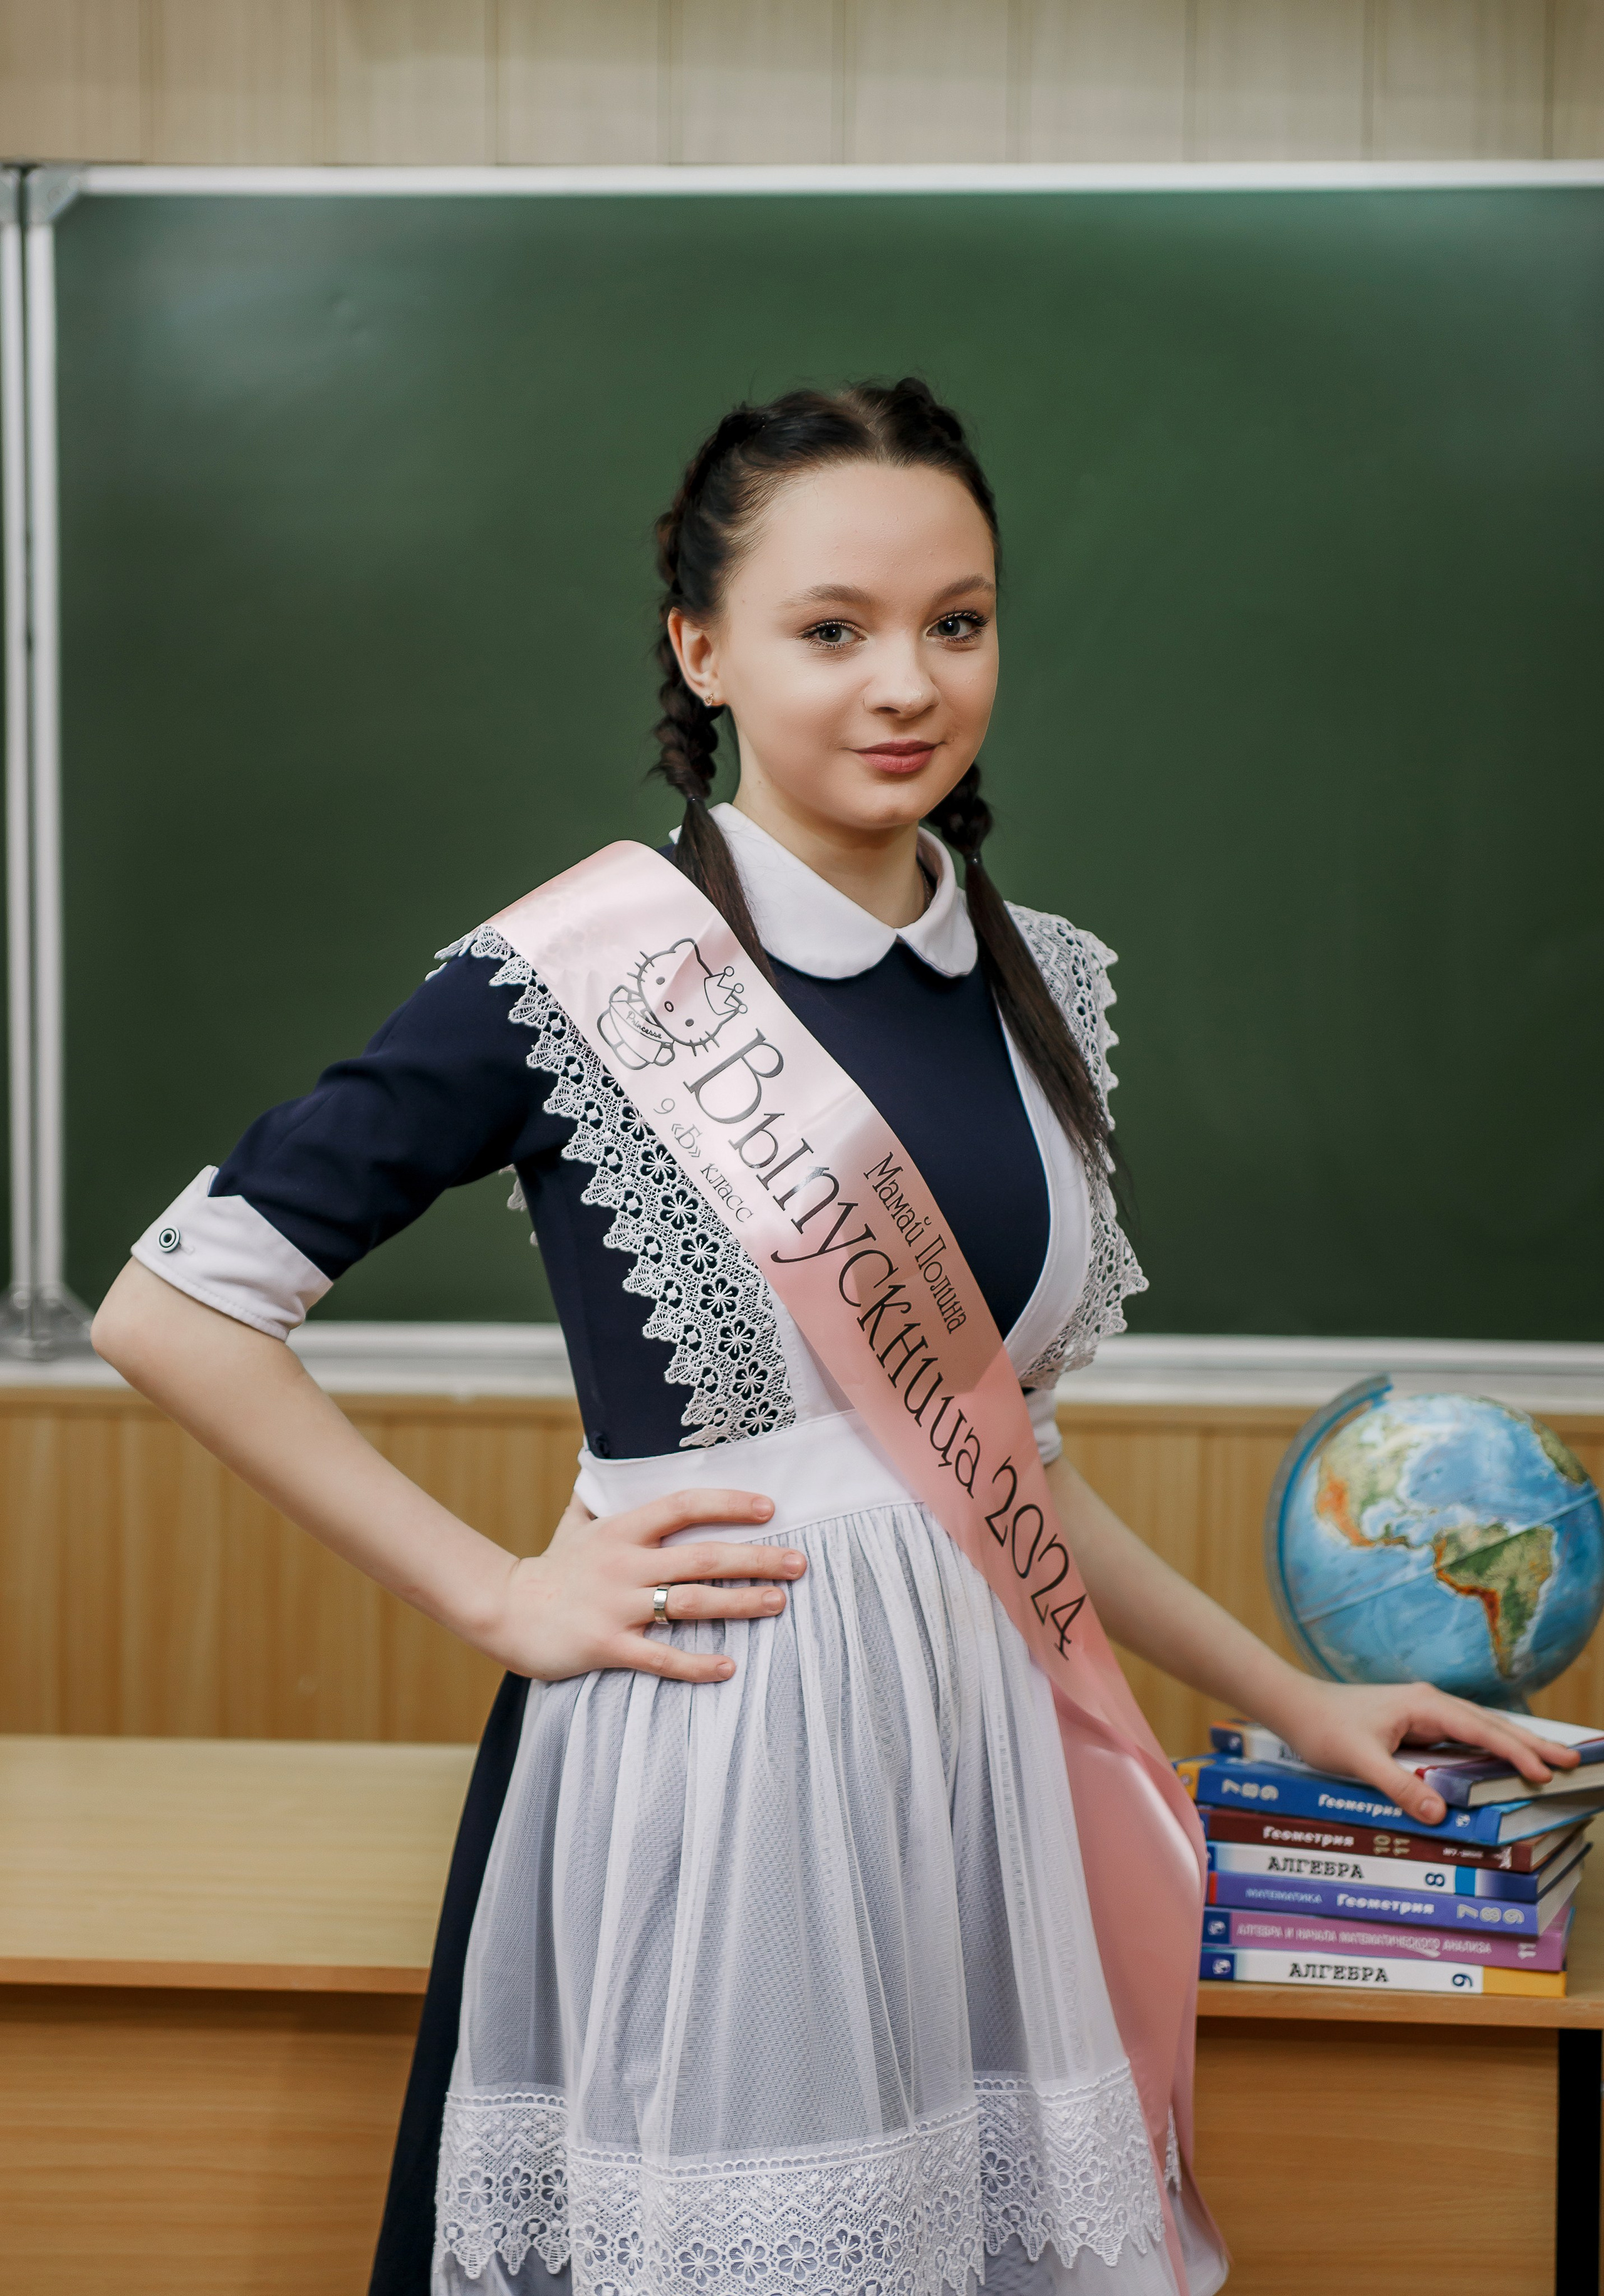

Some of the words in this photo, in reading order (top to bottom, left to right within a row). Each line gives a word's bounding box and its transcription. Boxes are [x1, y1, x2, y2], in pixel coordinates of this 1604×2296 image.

[626, 1010, 662, 1039] Princesse
[653, 1097, 675, 1115] 9
[670, 1123, 704, 1159] «Б»
[699, 1162, 754, 1223] класс
[863, 1151, 933, 1247] Мамай
[914, 1233, 967, 1335] Полина
[683, 1028, 981, 1499] Выпускница
[984, 1456, 1087, 1661] 2024
[1318, 1793, 1403, 1817] Геометрия
[1263, 1825, 1355, 1848] Геометрия
[1267, 1855, 1365, 1879] АЛГЕБРА
[1425, 1872, 1445, 1887] 8
[1336, 1892, 1435, 1916] Геометрия
[1289, 1962, 1390, 1983] АЛГЕБРА
